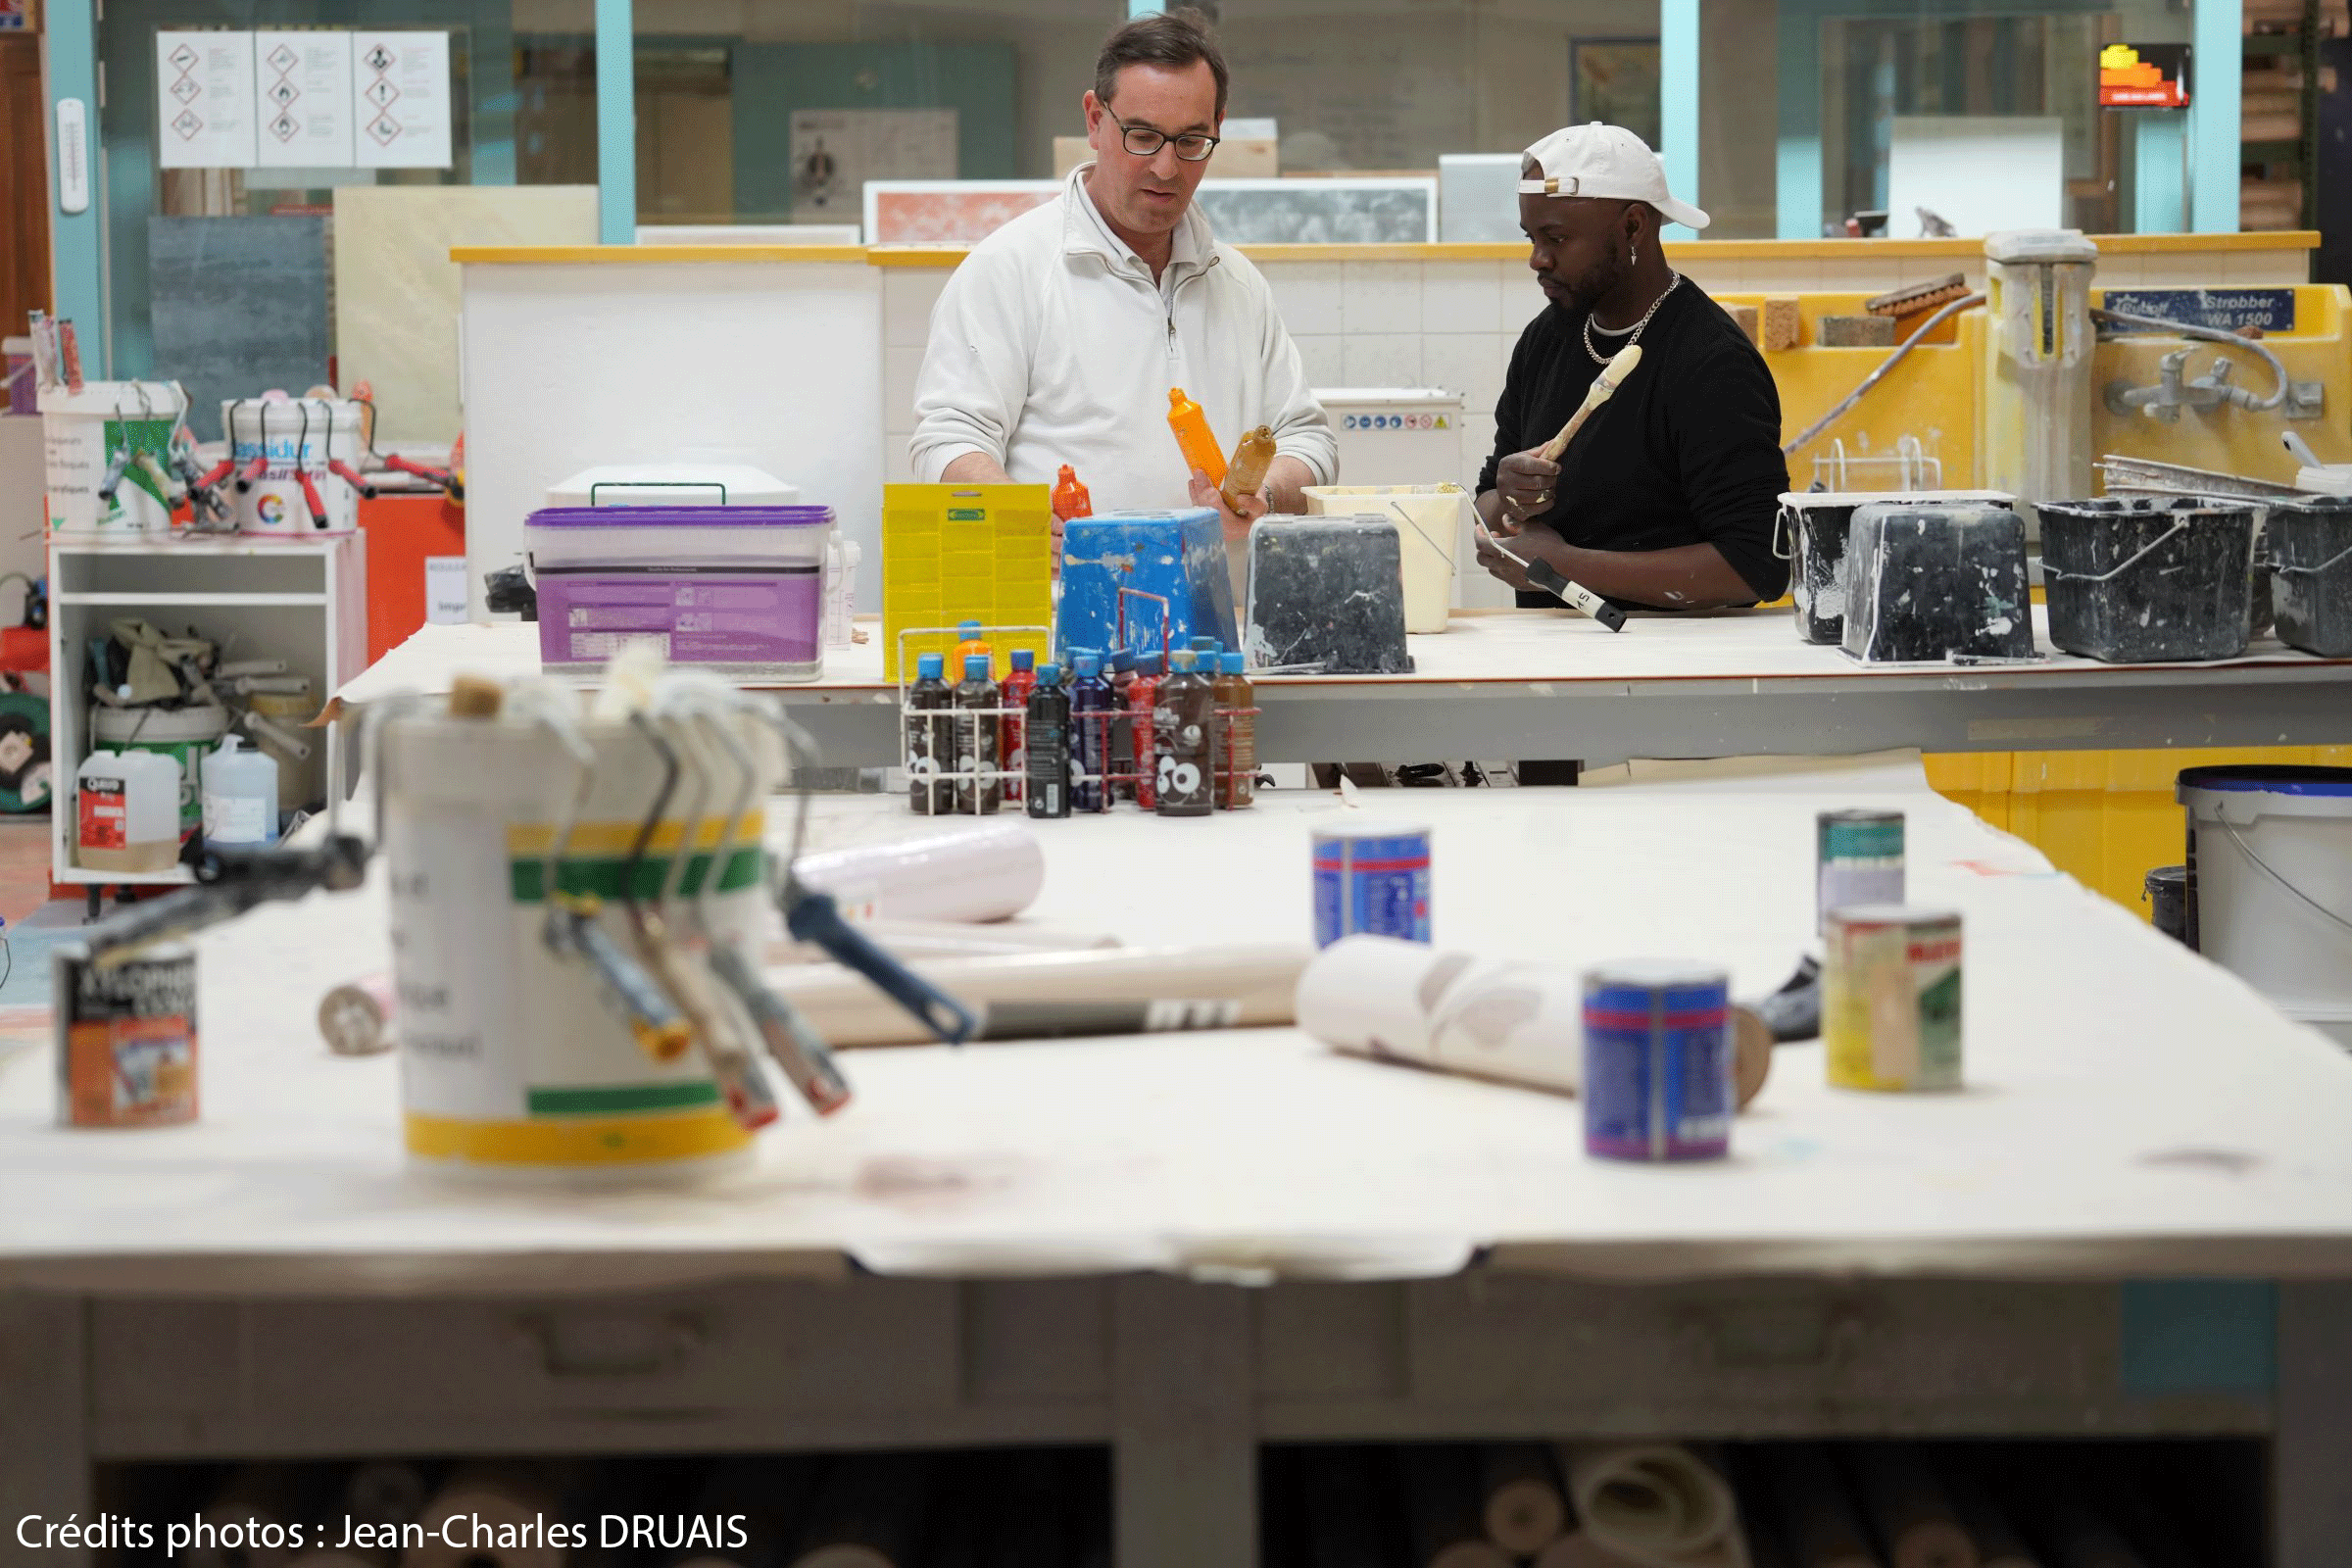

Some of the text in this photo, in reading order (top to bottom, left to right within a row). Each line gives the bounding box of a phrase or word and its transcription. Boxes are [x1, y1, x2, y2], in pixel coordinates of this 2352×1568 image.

[2204, 295, 2276, 310] Strobber
[2207, 312, 2274, 326] WA 1500
